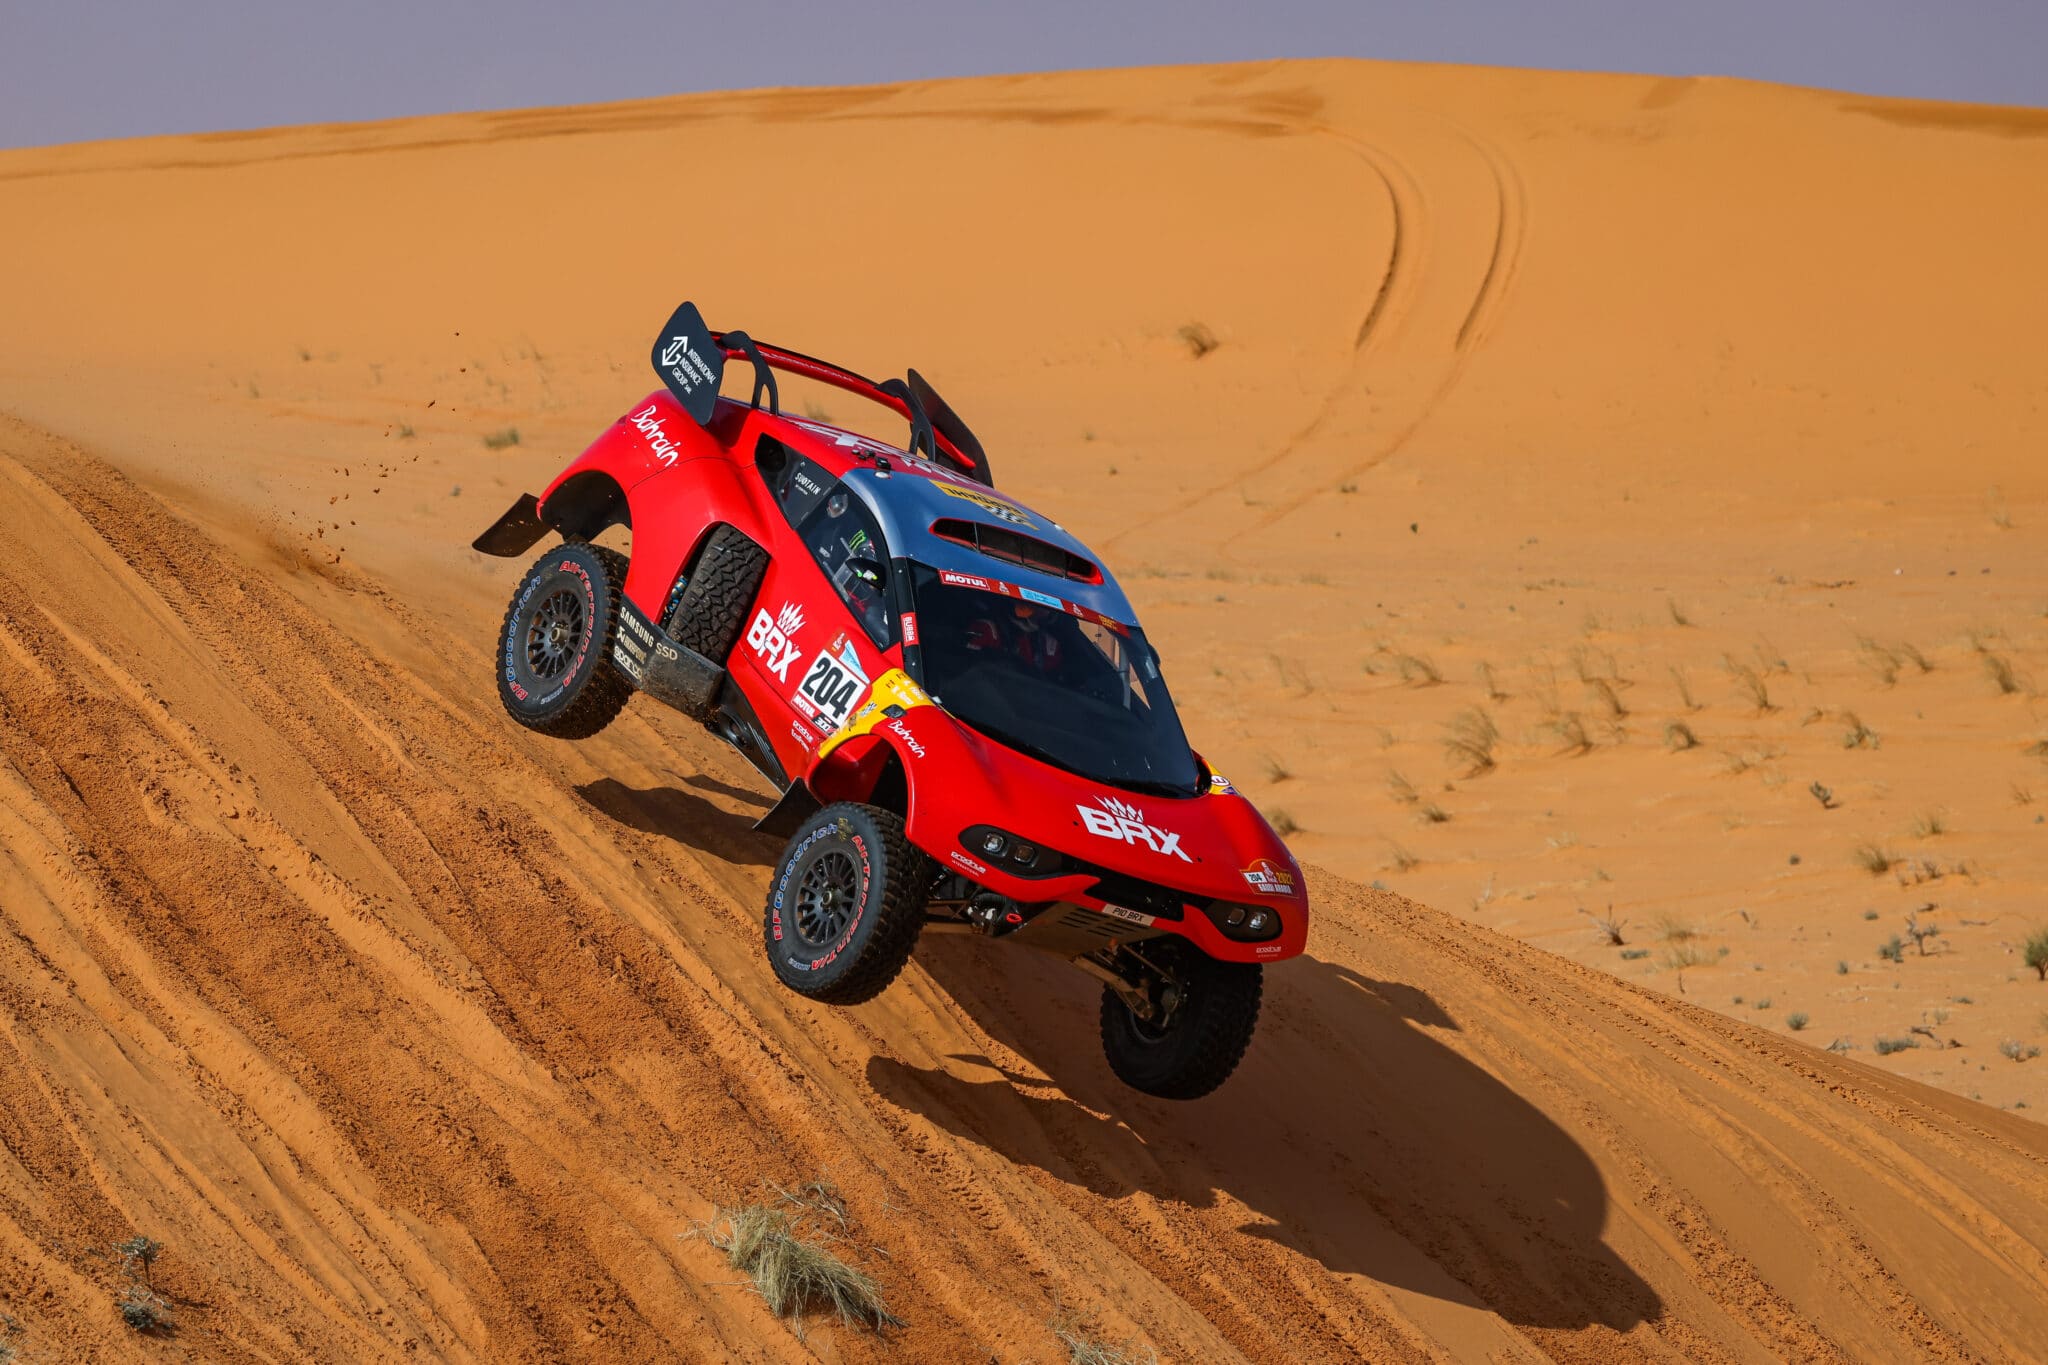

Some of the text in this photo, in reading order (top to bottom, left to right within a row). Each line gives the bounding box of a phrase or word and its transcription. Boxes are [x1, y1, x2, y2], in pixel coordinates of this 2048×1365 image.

[672, 367, 688, 385] GROUP
[679, 357, 703, 386] INSURANCE
[687, 348, 716, 384] INTERNATIONAL
[631, 405, 681, 467] Bahrain
[945, 574, 986, 587] MOTUL
[620, 606, 654, 647] SAMSUNG
[655, 642, 678, 660] SSD
[747, 608, 802, 684] BRX
[793, 694, 817, 717] MOTUL
[802, 657, 858, 719] 204
[888, 720, 925, 758] Bahrain
[1076, 804, 1193, 863] BRX
[1249, 873, 1263, 882] 204
[1126, 911, 1144, 923] BRX
